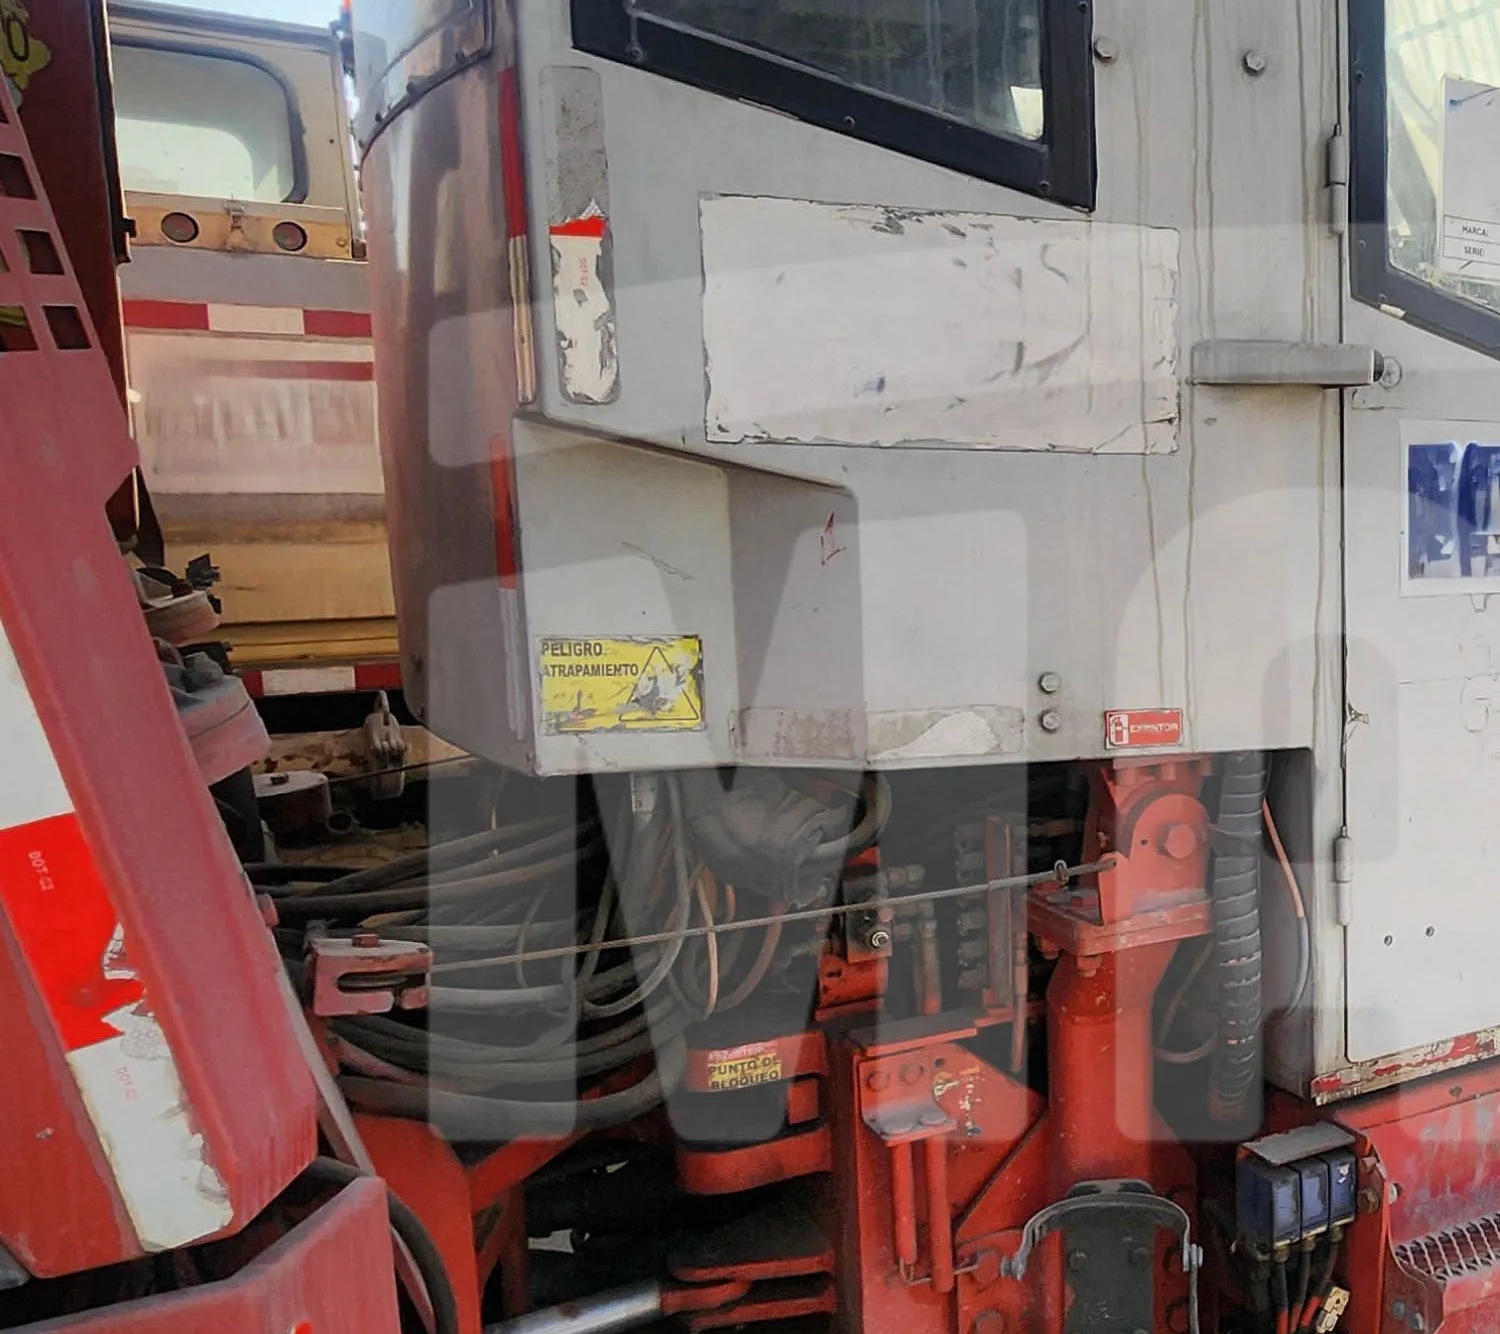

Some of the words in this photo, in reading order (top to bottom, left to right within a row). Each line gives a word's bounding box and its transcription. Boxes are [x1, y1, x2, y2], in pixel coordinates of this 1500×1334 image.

[541, 642, 604, 657] PELIGRO
[542, 663, 640, 678] ATRAPAMIENTO
[708, 1060, 758, 1076] PUNTO
[711, 1070, 779, 1090] BLOQUEO
